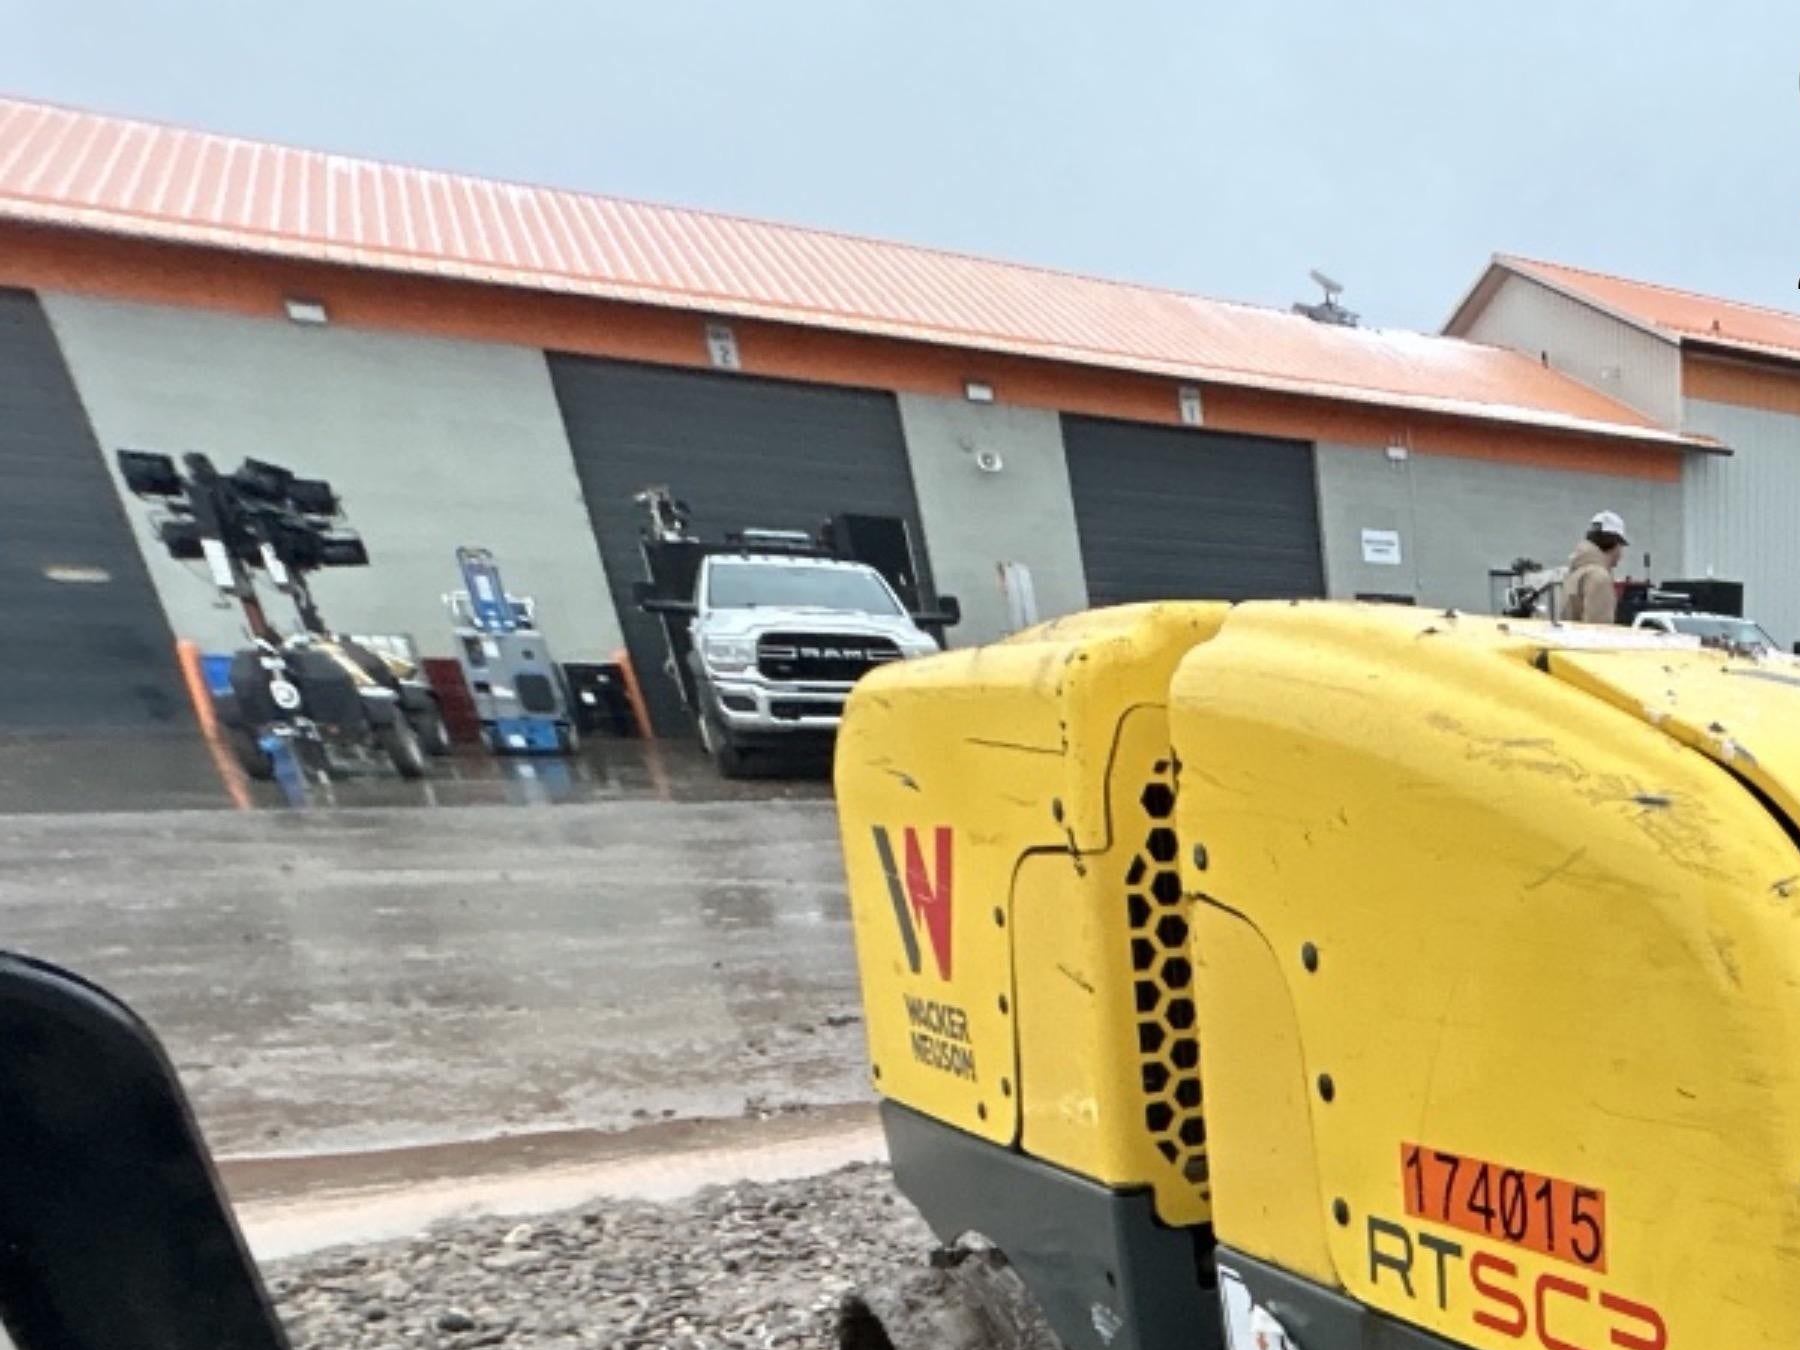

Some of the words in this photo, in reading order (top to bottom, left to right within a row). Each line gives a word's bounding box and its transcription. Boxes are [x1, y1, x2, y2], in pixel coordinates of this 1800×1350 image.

[800, 647, 862, 659] RAM
[904, 993, 972, 1044] WACKER
[911, 1031, 978, 1083] NEUSON
[1406, 1145, 1602, 1265] 174015
